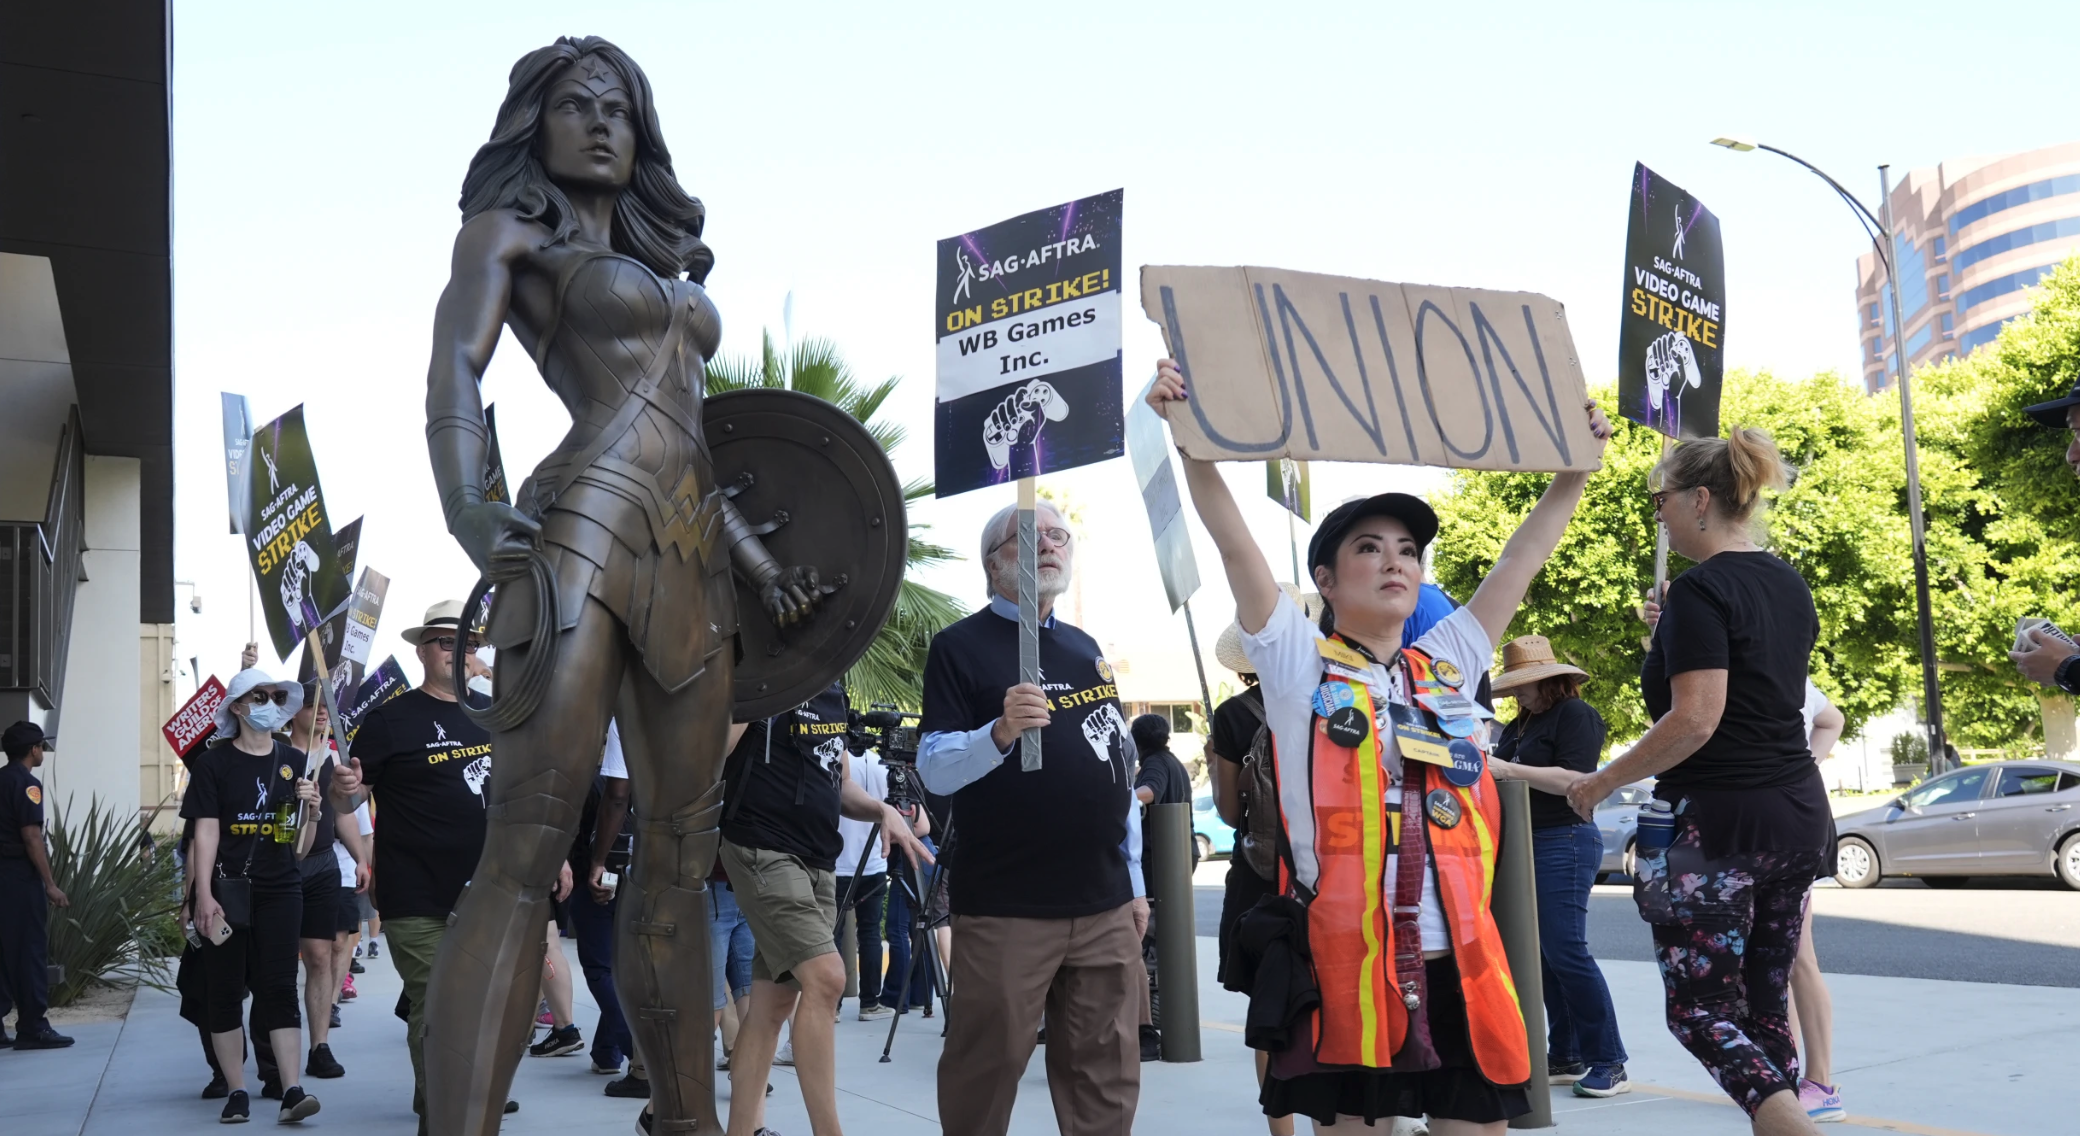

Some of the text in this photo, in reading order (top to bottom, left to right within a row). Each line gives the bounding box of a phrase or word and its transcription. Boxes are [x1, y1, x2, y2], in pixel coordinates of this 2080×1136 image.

[946, 268, 1110, 331] ON STRIKE!
[1634, 266, 1720, 322] VIDEO GAME
[958, 308, 1096, 357] WB Games
[1631, 287, 1718, 349] STRIKE
[999, 351, 1049, 375] Inc.
[1160, 282, 1572, 467] UNION
[252, 485, 318, 551] VIDEO GAME
[257, 501, 322, 576] STRIKE
[350, 625, 369, 642] Games
[167, 684, 218, 734] WRITERS
[174, 694, 223, 739] GUILD OF
[178, 706, 220, 751] AMERIC
[1397, 723, 1410, 731] ON
[428, 744, 492, 765] ON STRIK
[1453, 759, 1482, 773] GMA
[1431, 808, 1452, 828] WGA
